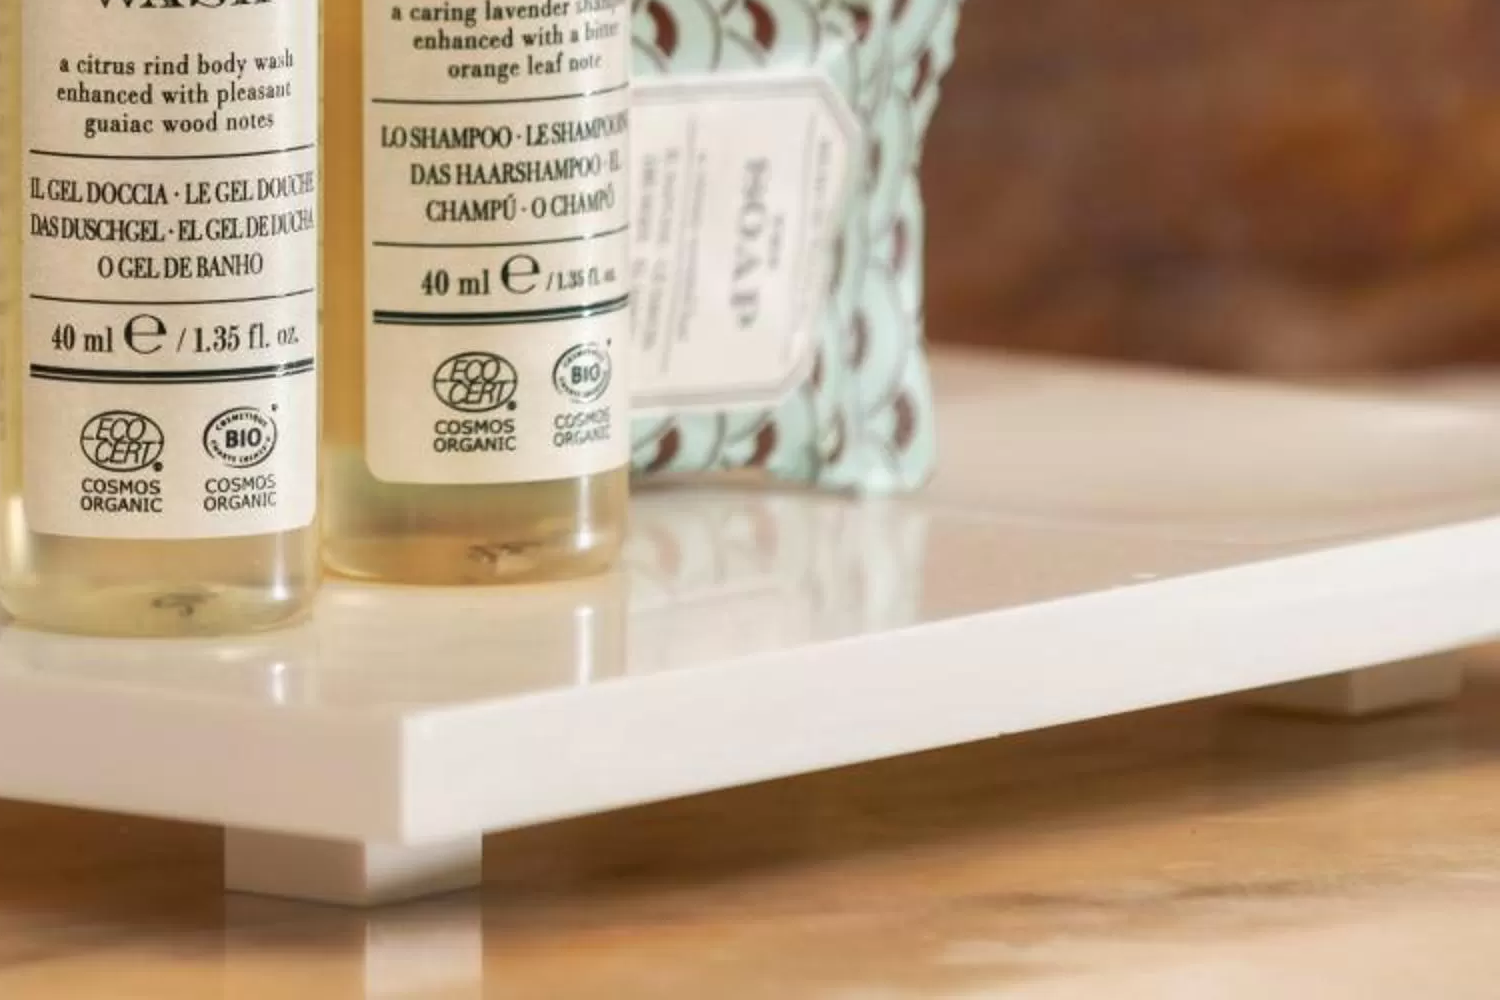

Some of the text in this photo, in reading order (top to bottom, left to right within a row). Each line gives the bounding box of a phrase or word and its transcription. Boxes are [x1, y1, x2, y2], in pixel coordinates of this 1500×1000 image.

[392, 6, 401, 20] a
[410, 1, 476, 26] caring
[413, 25, 513, 50] enhanced
[521, 23, 563, 47] with
[570, 31, 579, 44] a
[60, 49, 294, 81] a citrus rind body wash
[448, 56, 520, 83] orange
[528, 55, 562, 77] leaf
[57, 80, 291, 110] enhanced with pleasant
[84, 109, 274, 139] guaiac wood notes
[382, 125, 407, 148] LO
[410, 126, 512, 150] SHAMPOO
[526, 123, 548, 147] LE
[410, 163, 451, 186] DAS
[456, 155, 600, 185] HAARSHAMPOO
[30, 170, 314, 205] IL GEL DOCCIA LE GEL DOUCHE
[426, 193, 516, 222] CHAMPÚ
[531, 196, 547, 218] O
[31, 207, 314, 242] DAS DUSCHGEL EL GEL DE DUCHA
[98, 253, 263, 279] O GEL DE BANHO
[421, 269, 449, 296] 40
[459, 269, 489, 295] ml
[52, 324, 75, 351] 40
[84, 326, 113, 353] ml
[194, 326, 240, 352] 1.35
[248, 324, 270, 349] fl.
[277, 324, 299, 346] oz.
[451, 359, 501, 380] ECO
[571, 362, 600, 385] BIO
[448, 380, 510, 404] CERT
[97, 418, 146, 439] ECO
[225, 427, 262, 448] BIO
[435, 420, 514, 434] COSMOS
[94, 440, 154, 464] CERT
[433, 437, 516, 452] ORGANIC
[81, 479, 161, 494] COSMOS
[205, 474, 276, 494] COSMOS
[80, 497, 162, 513] ORGANIC
[203, 491, 276, 512] ORGANIC
